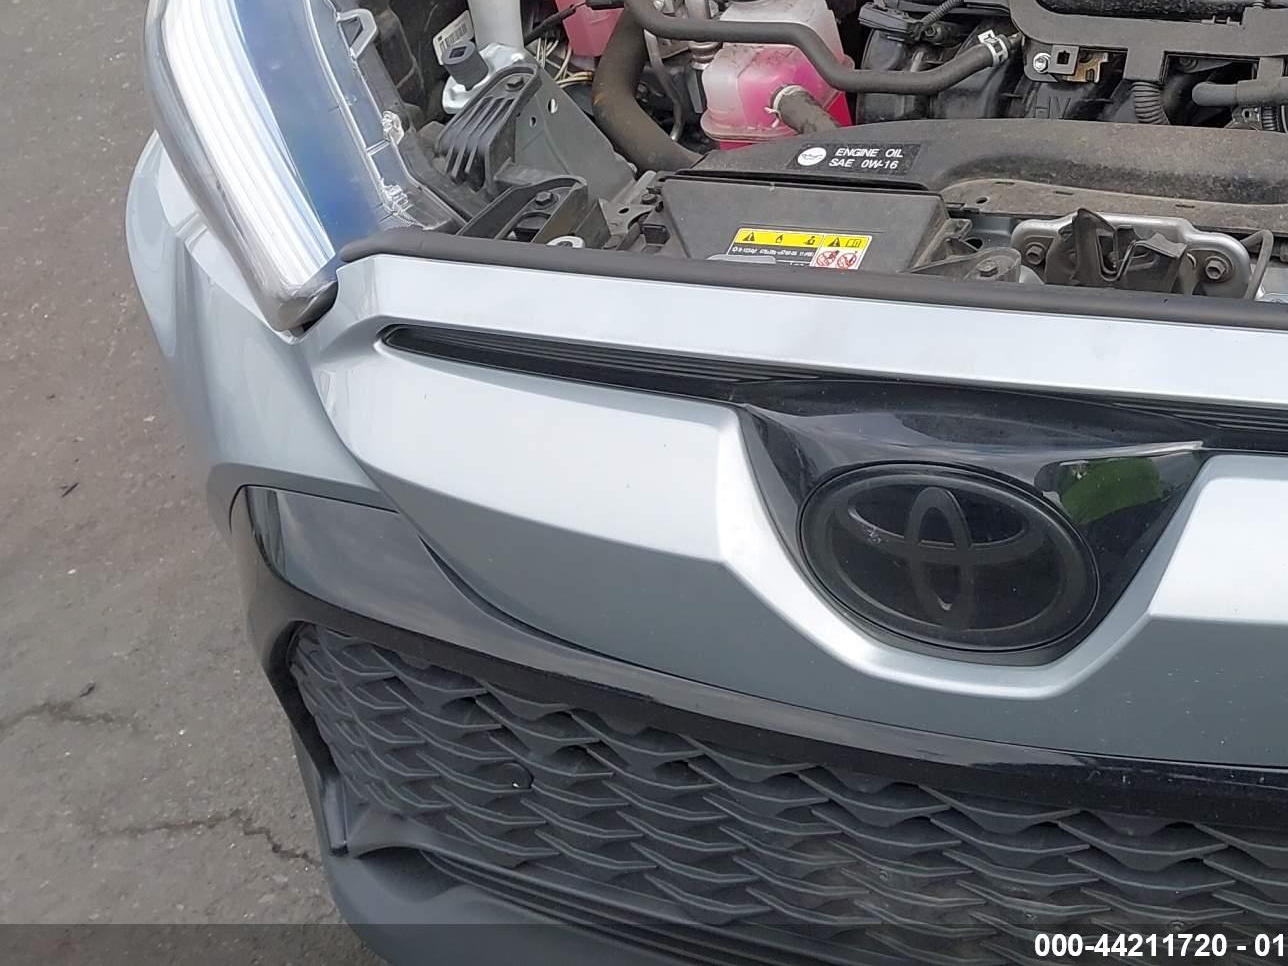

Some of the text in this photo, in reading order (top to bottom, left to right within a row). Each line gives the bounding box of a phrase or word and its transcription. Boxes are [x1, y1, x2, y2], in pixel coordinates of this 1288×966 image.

[835, 147, 904, 158] ENGINE OIL
[829, 158, 899, 169] SAE 0W-16
